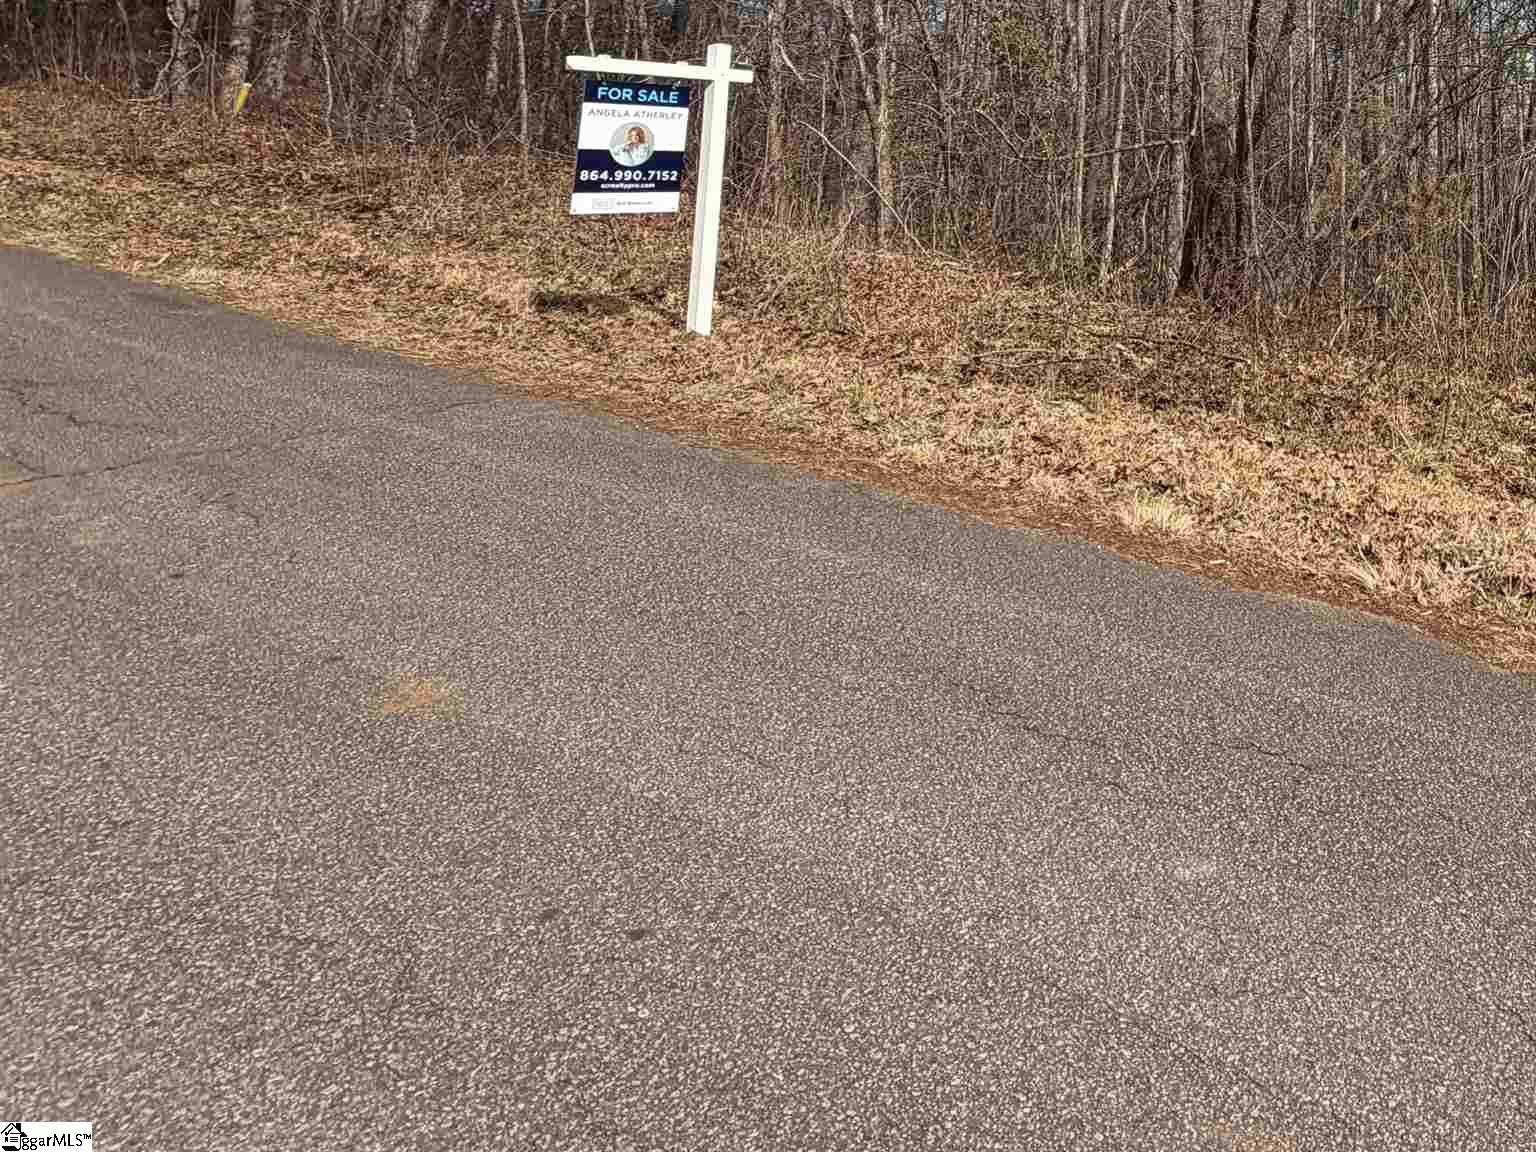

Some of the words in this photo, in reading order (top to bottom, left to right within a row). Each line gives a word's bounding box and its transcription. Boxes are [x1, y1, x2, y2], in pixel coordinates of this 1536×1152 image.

[598, 87, 633, 101] FOR
[637, 89, 679, 104] SALE
[587, 108, 631, 117] ANGELA
[633, 110, 683, 119] ATHERLEY
[579, 170, 678, 181] 864.990.7152
